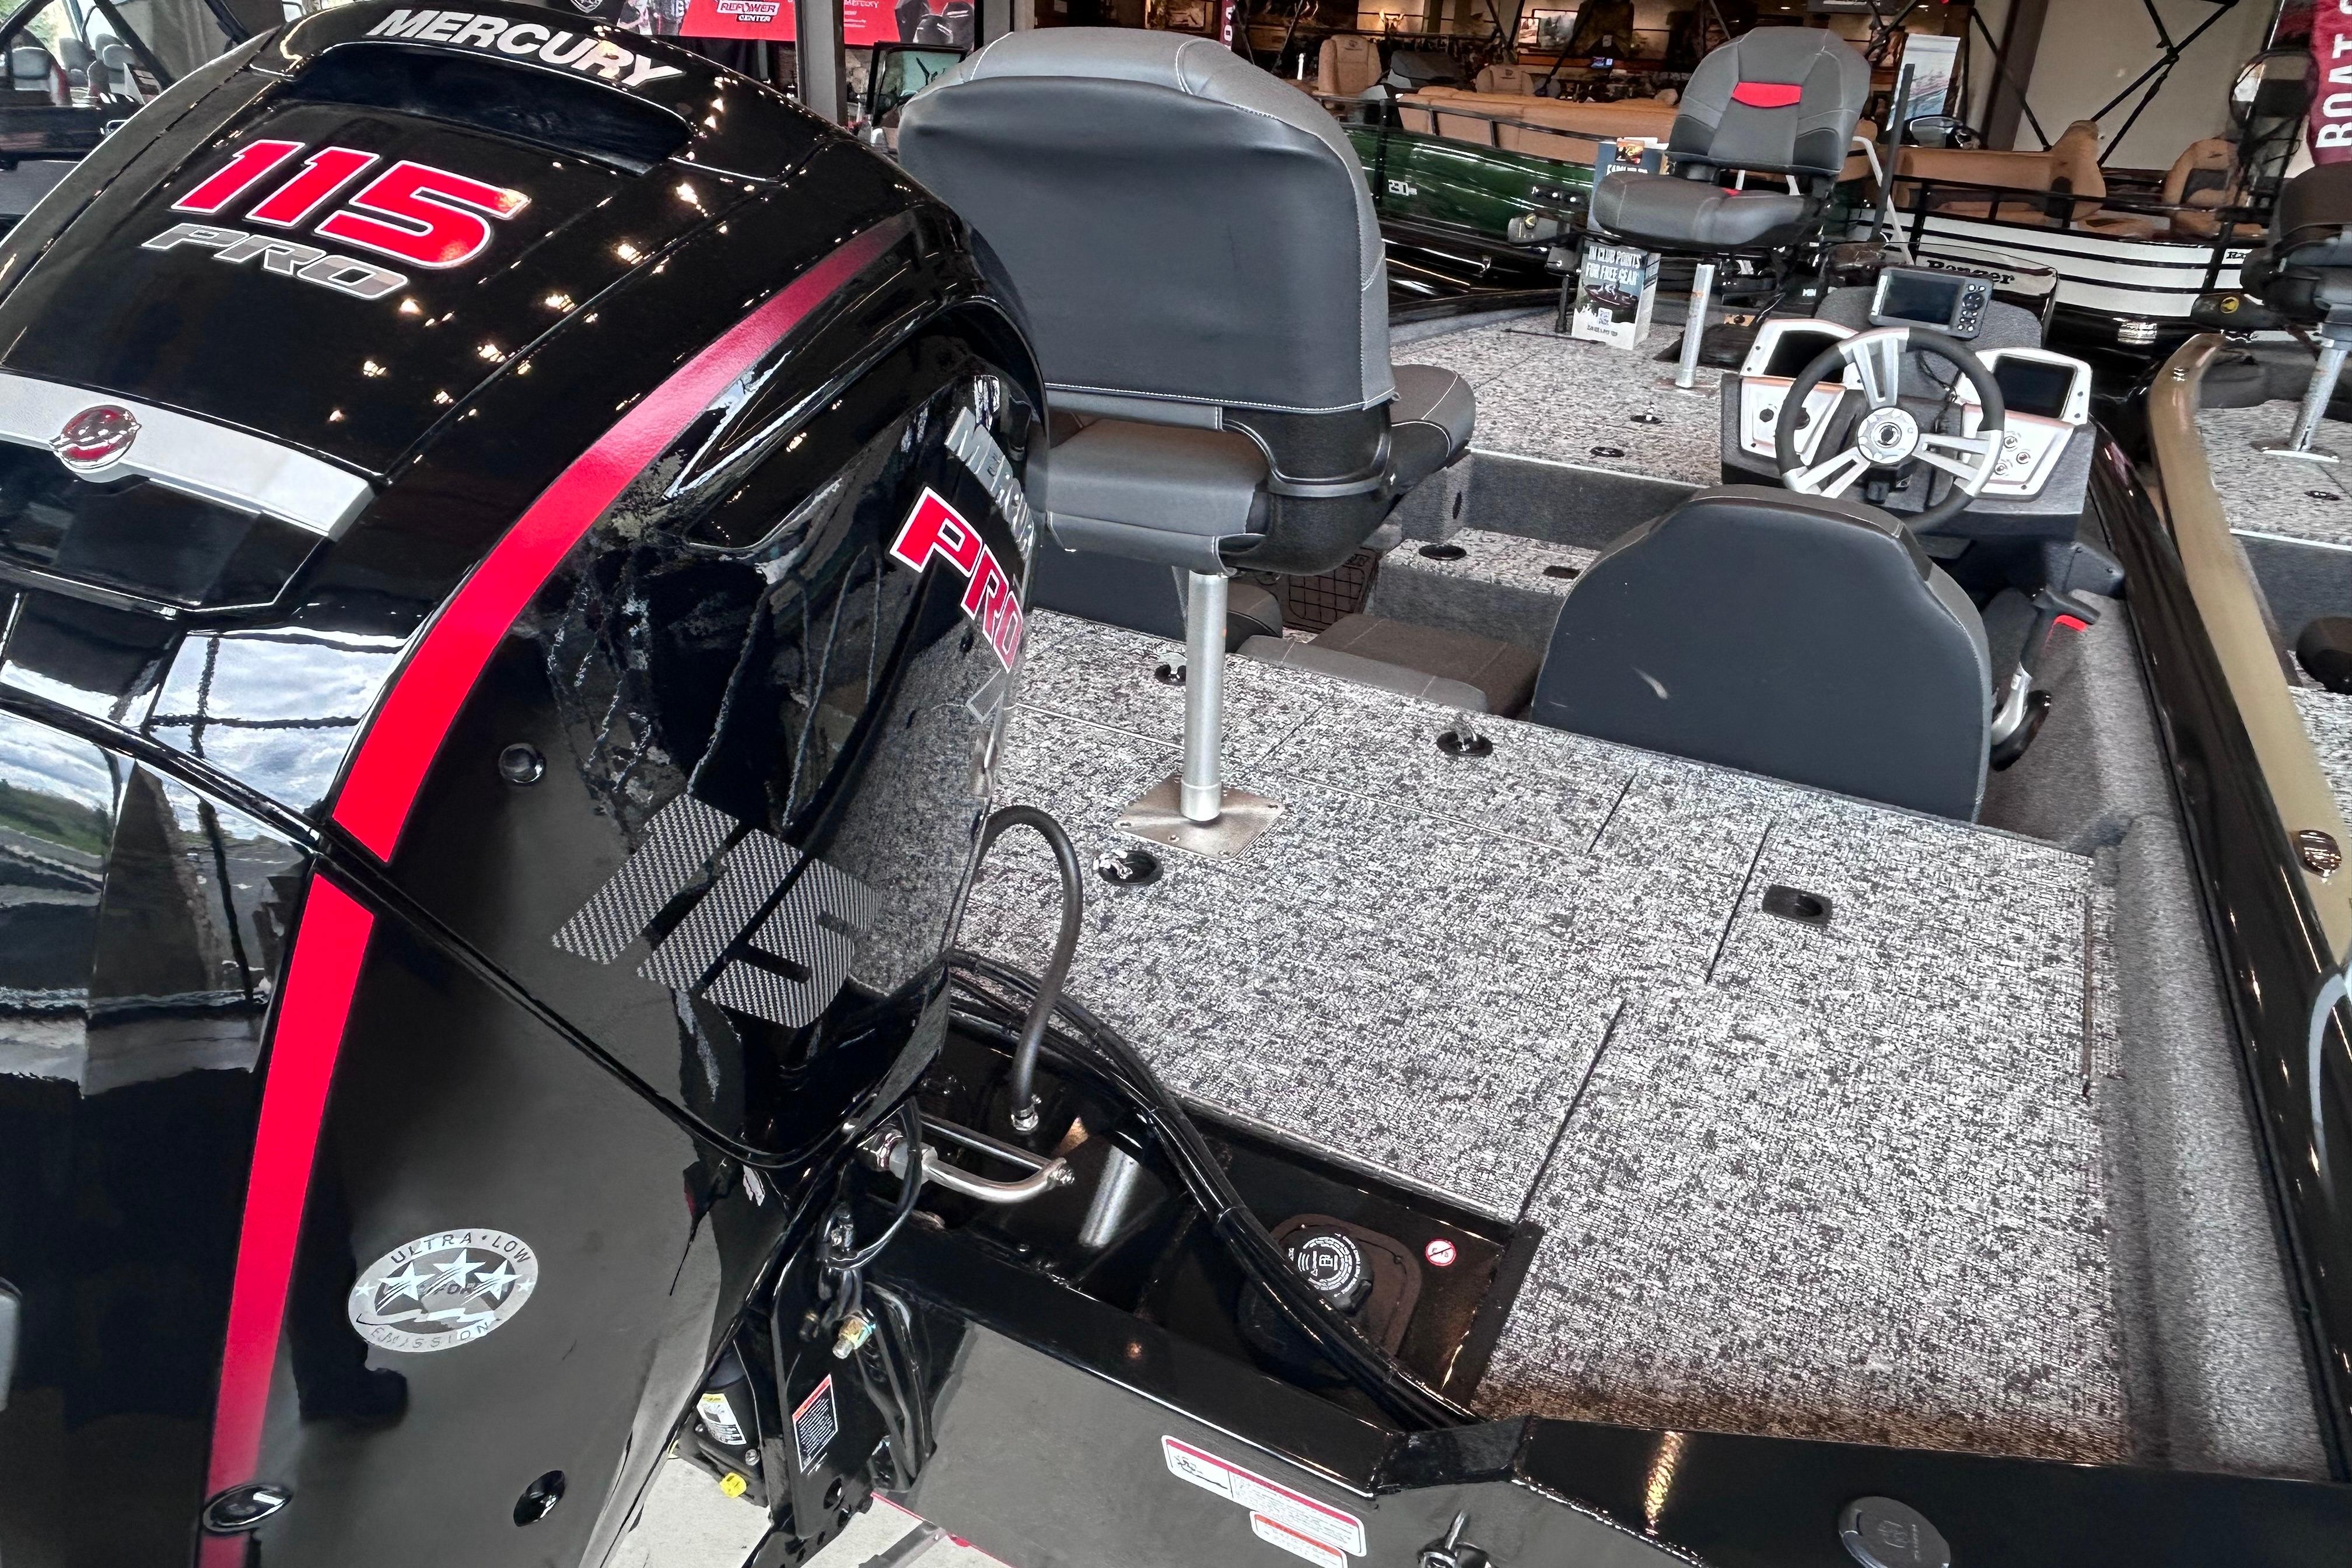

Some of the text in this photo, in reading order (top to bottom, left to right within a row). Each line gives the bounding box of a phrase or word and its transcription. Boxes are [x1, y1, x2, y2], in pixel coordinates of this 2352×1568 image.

[366, 9, 684, 88] MERCURY
[170, 139, 531, 269] 115
[141, 222, 409, 300] PRO
[889, 487, 1024, 674] PRO
[551, 793, 877, 1029] 115
[370, 1321, 489, 1349] EMISSION
